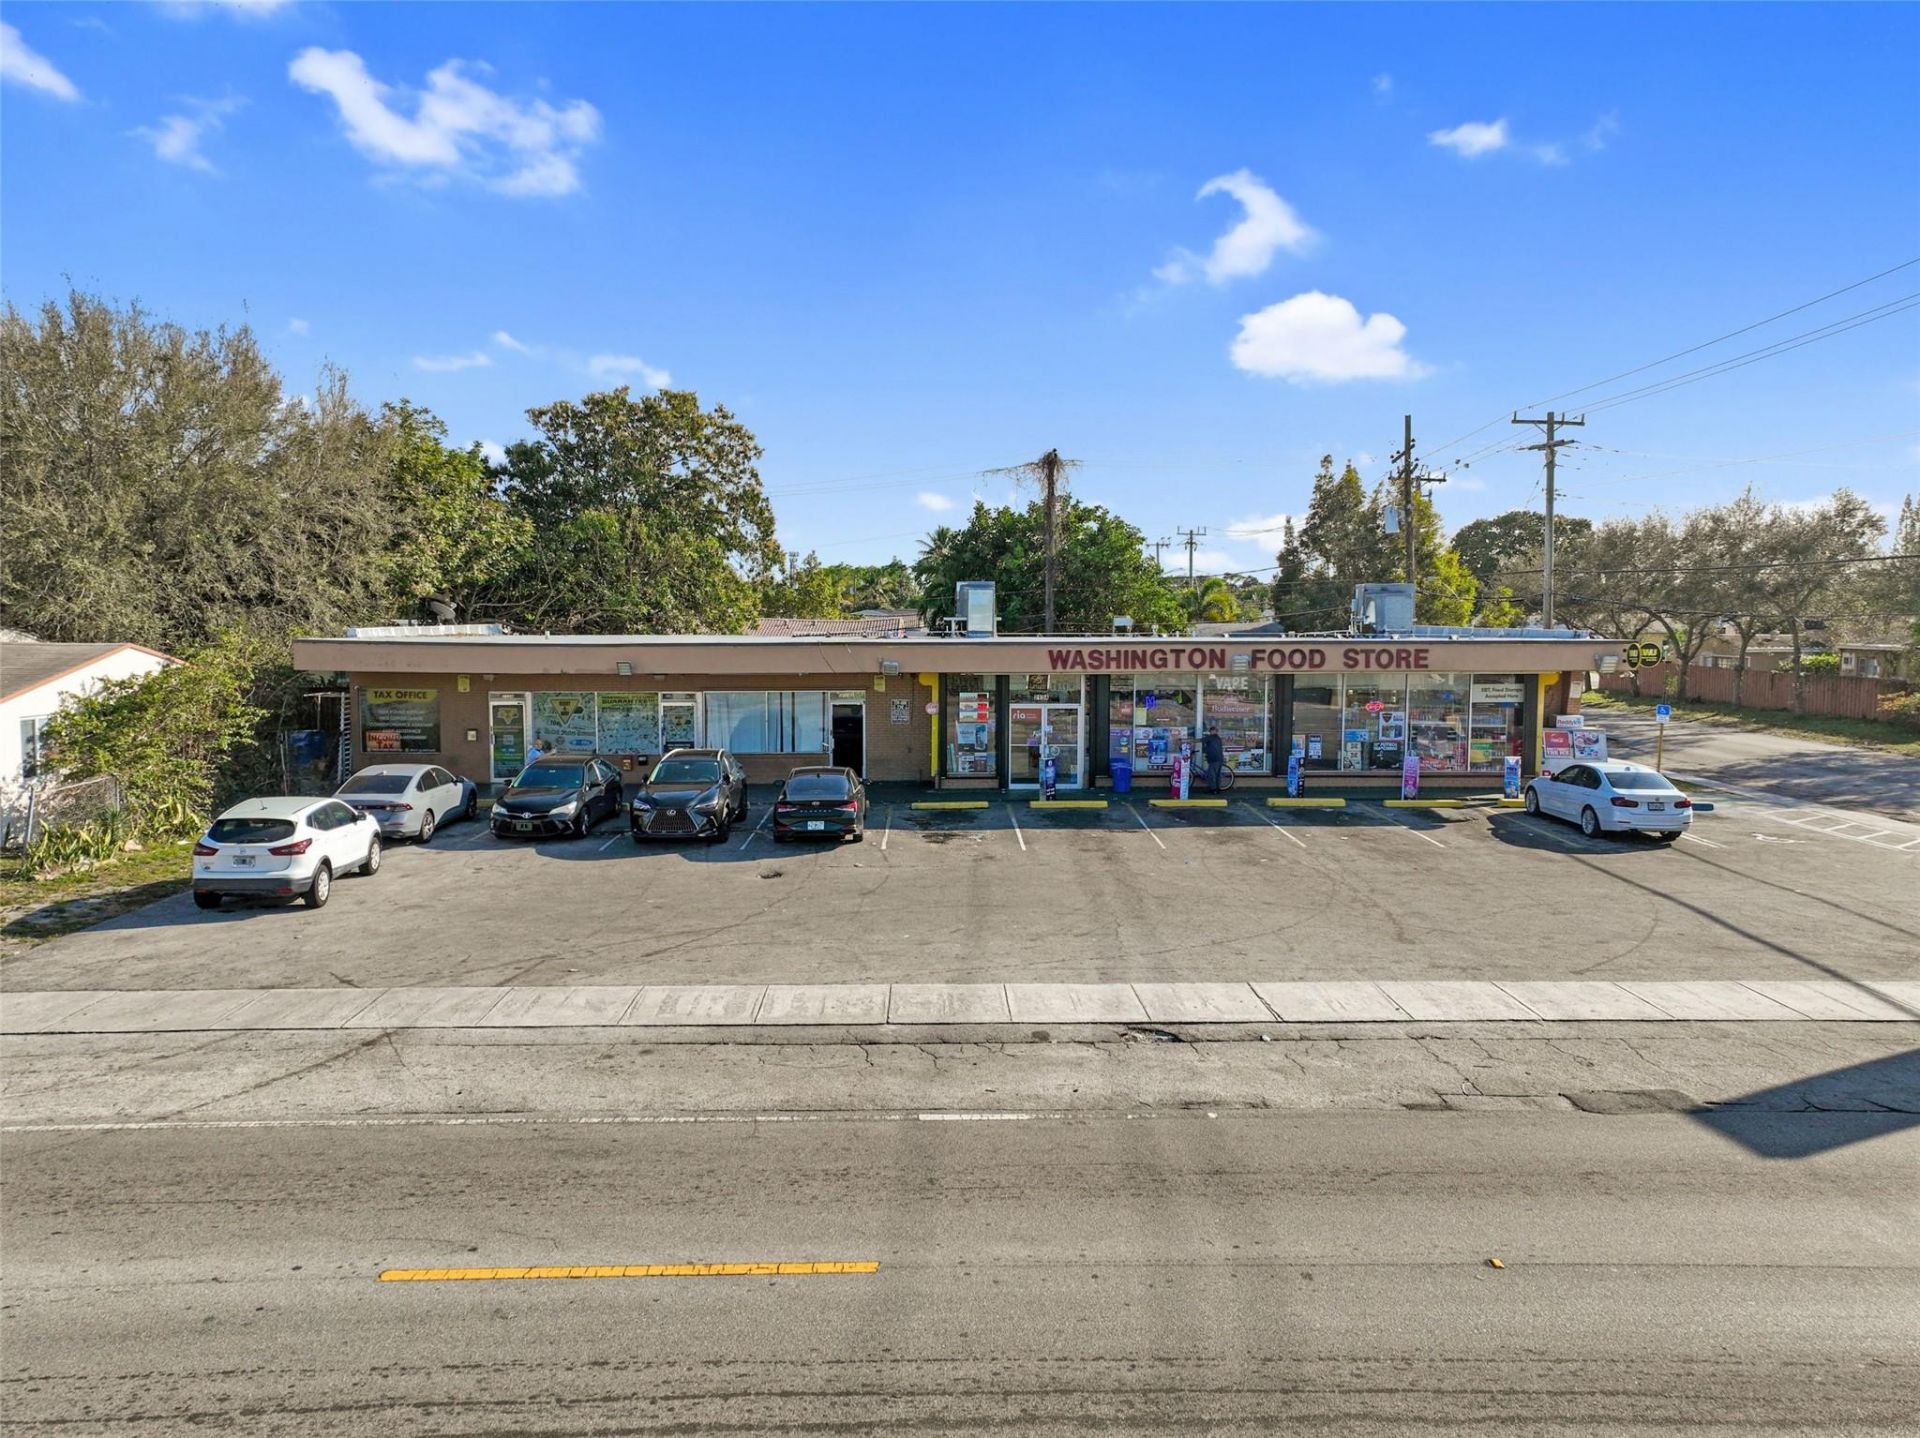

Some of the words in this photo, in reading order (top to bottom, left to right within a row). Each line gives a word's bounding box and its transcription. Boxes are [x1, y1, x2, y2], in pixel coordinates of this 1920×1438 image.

[1048, 648, 1226, 670] WASHINGTON
[1251, 648, 1326, 669] FOOD
[1343, 648, 1430, 669] STORE
[1216, 677, 1248, 689] VAPE
[374, 691, 392, 699] TAX
[395, 691, 428, 699] OFFICE
